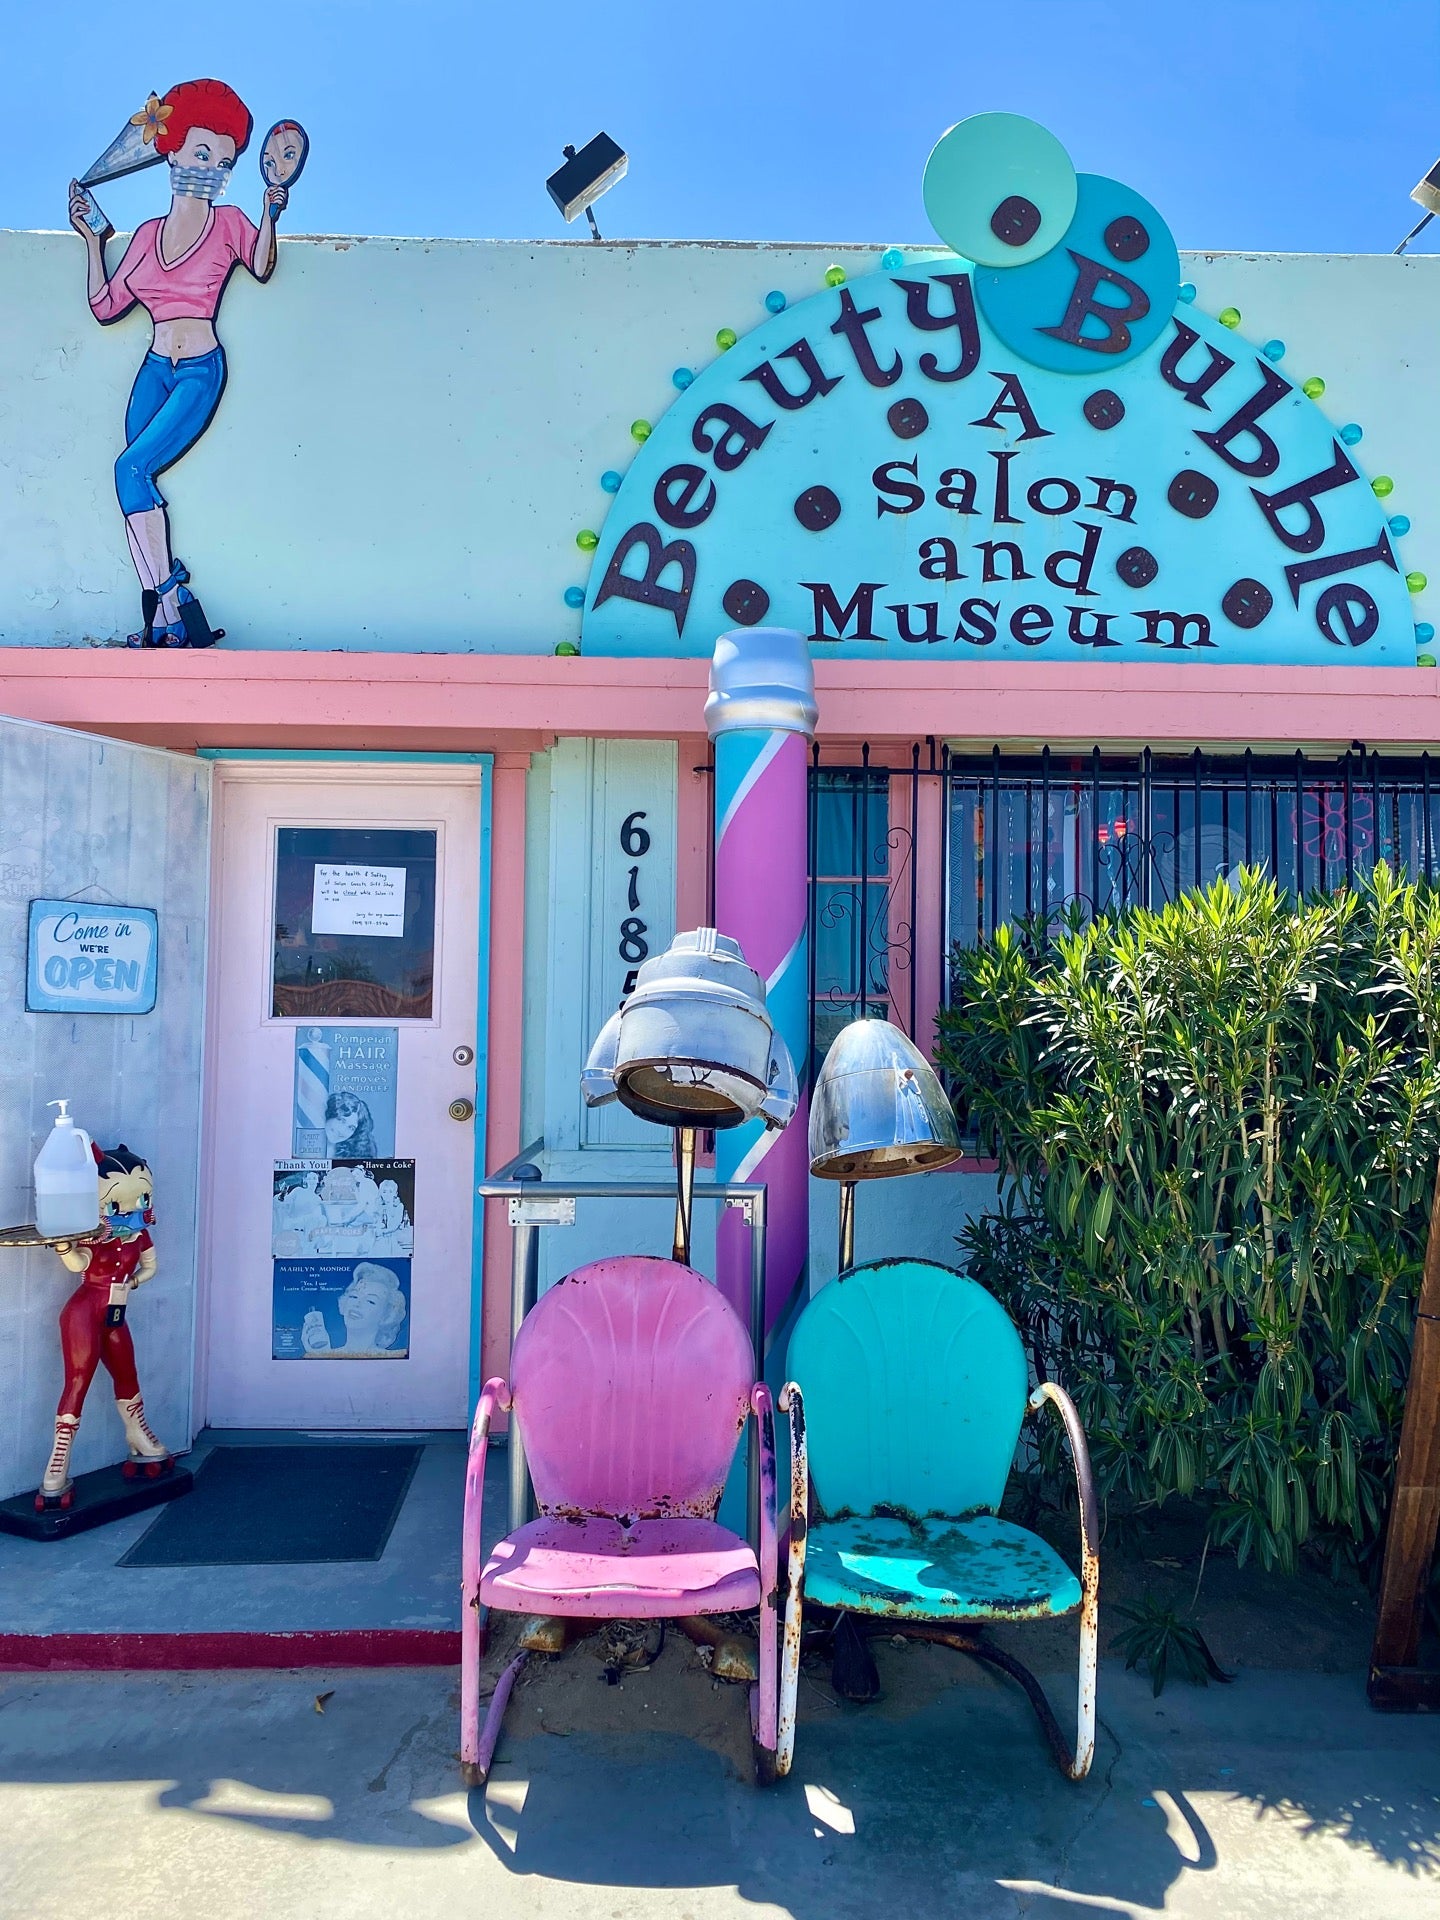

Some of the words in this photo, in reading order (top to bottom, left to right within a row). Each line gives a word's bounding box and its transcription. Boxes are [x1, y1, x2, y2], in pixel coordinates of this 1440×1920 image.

[970, 372, 1054, 441] A
[592, 274, 980, 638] Beauty
[1036, 249, 1399, 646] Bubble
[873, 451, 1137, 525] Salon
[919, 521, 1102, 596] and
[798, 583, 1219, 649] Museum
[53, 912, 109, 942] Come
[115, 922, 132, 937] in
[79, 943, 109, 954] WE'RE
[44, 955, 140, 992] OPEN
[334, 1033, 391, 1045] Pompeian
[339, 1047, 386, 1059] HAIR
[335, 1060, 390, 1073] Massage
[337, 1074, 387, 1083] Removes
[309, 1160, 328, 1169] You!
[113, 1308, 121, 1322] B
